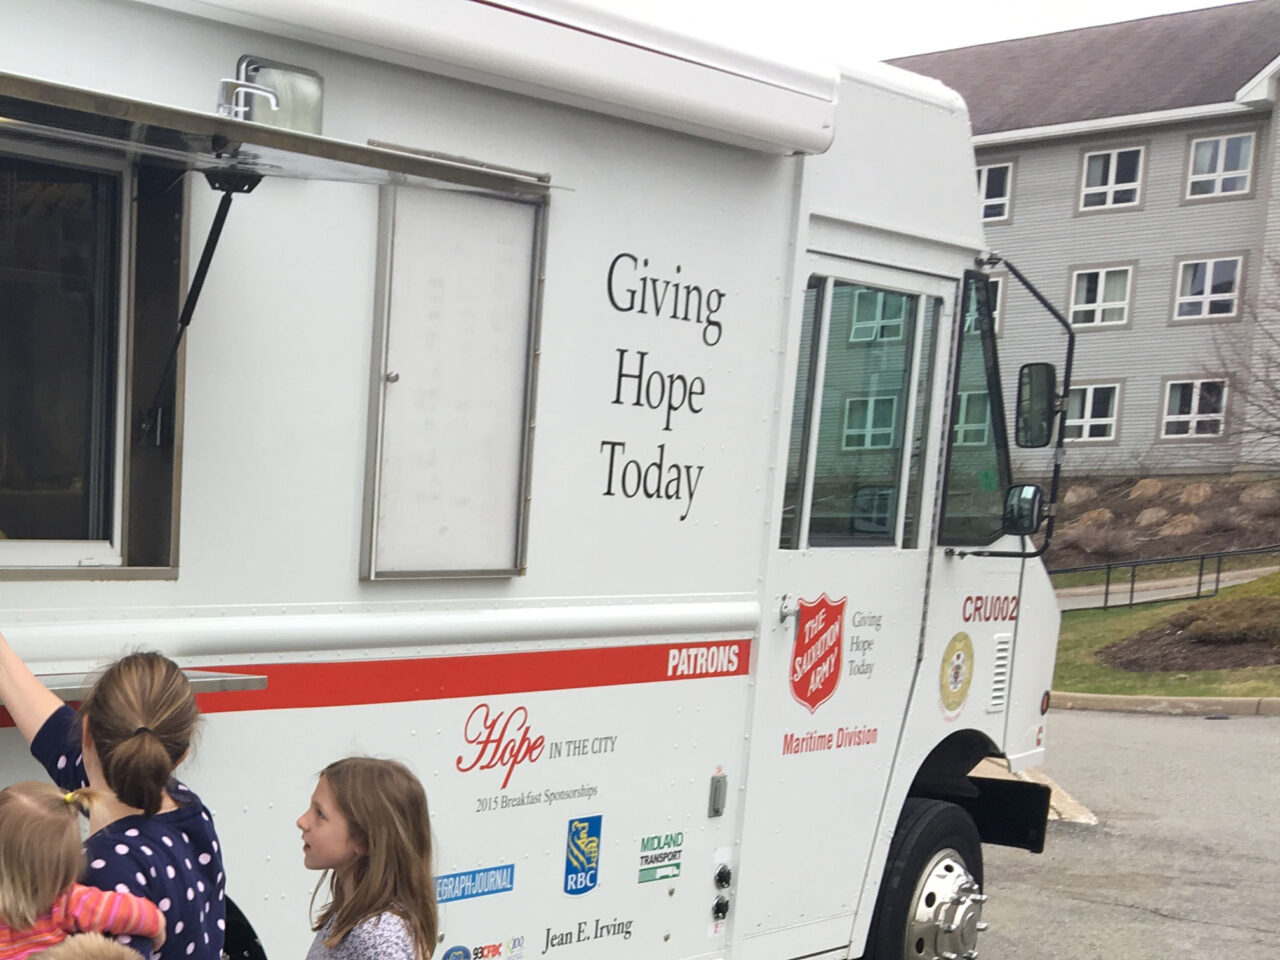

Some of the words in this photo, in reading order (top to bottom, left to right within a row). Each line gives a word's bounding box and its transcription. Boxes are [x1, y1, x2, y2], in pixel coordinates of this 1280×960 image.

[607, 252, 726, 346] Giving
[611, 348, 705, 431] Hope
[600, 440, 705, 521] Today
[852, 611, 882, 632] Giving
[962, 595, 1018, 623] CRU002
[804, 608, 827, 643] THE
[667, 645, 739, 677] PATRONS
[793, 615, 842, 682] SALVATION
[850, 636, 874, 657] Hope
[807, 646, 838, 697] ARMY
[848, 660, 875, 680] Today
[456, 703, 545, 790] Hope
[549, 742, 561, 760] IN
[565, 739, 589, 757] THE
[591, 736, 618, 754] CITY
[782, 730, 833, 756] Maritime
[836, 725, 878, 749] Division
[476, 796, 499, 813] 2015
[500, 791, 542, 809] Breakfast
[543, 785, 598, 805] Sponsorships
[640, 850, 682, 866] TRANSPORT
[641, 832, 683, 852] MIDLAND
[436, 867, 512, 901] EGRAPH-JOURNAL
[567, 870, 596, 891] RBC
[541, 928, 573, 955] Jean
[576, 921, 590, 943] E.
[593, 917, 634, 941] Irving
